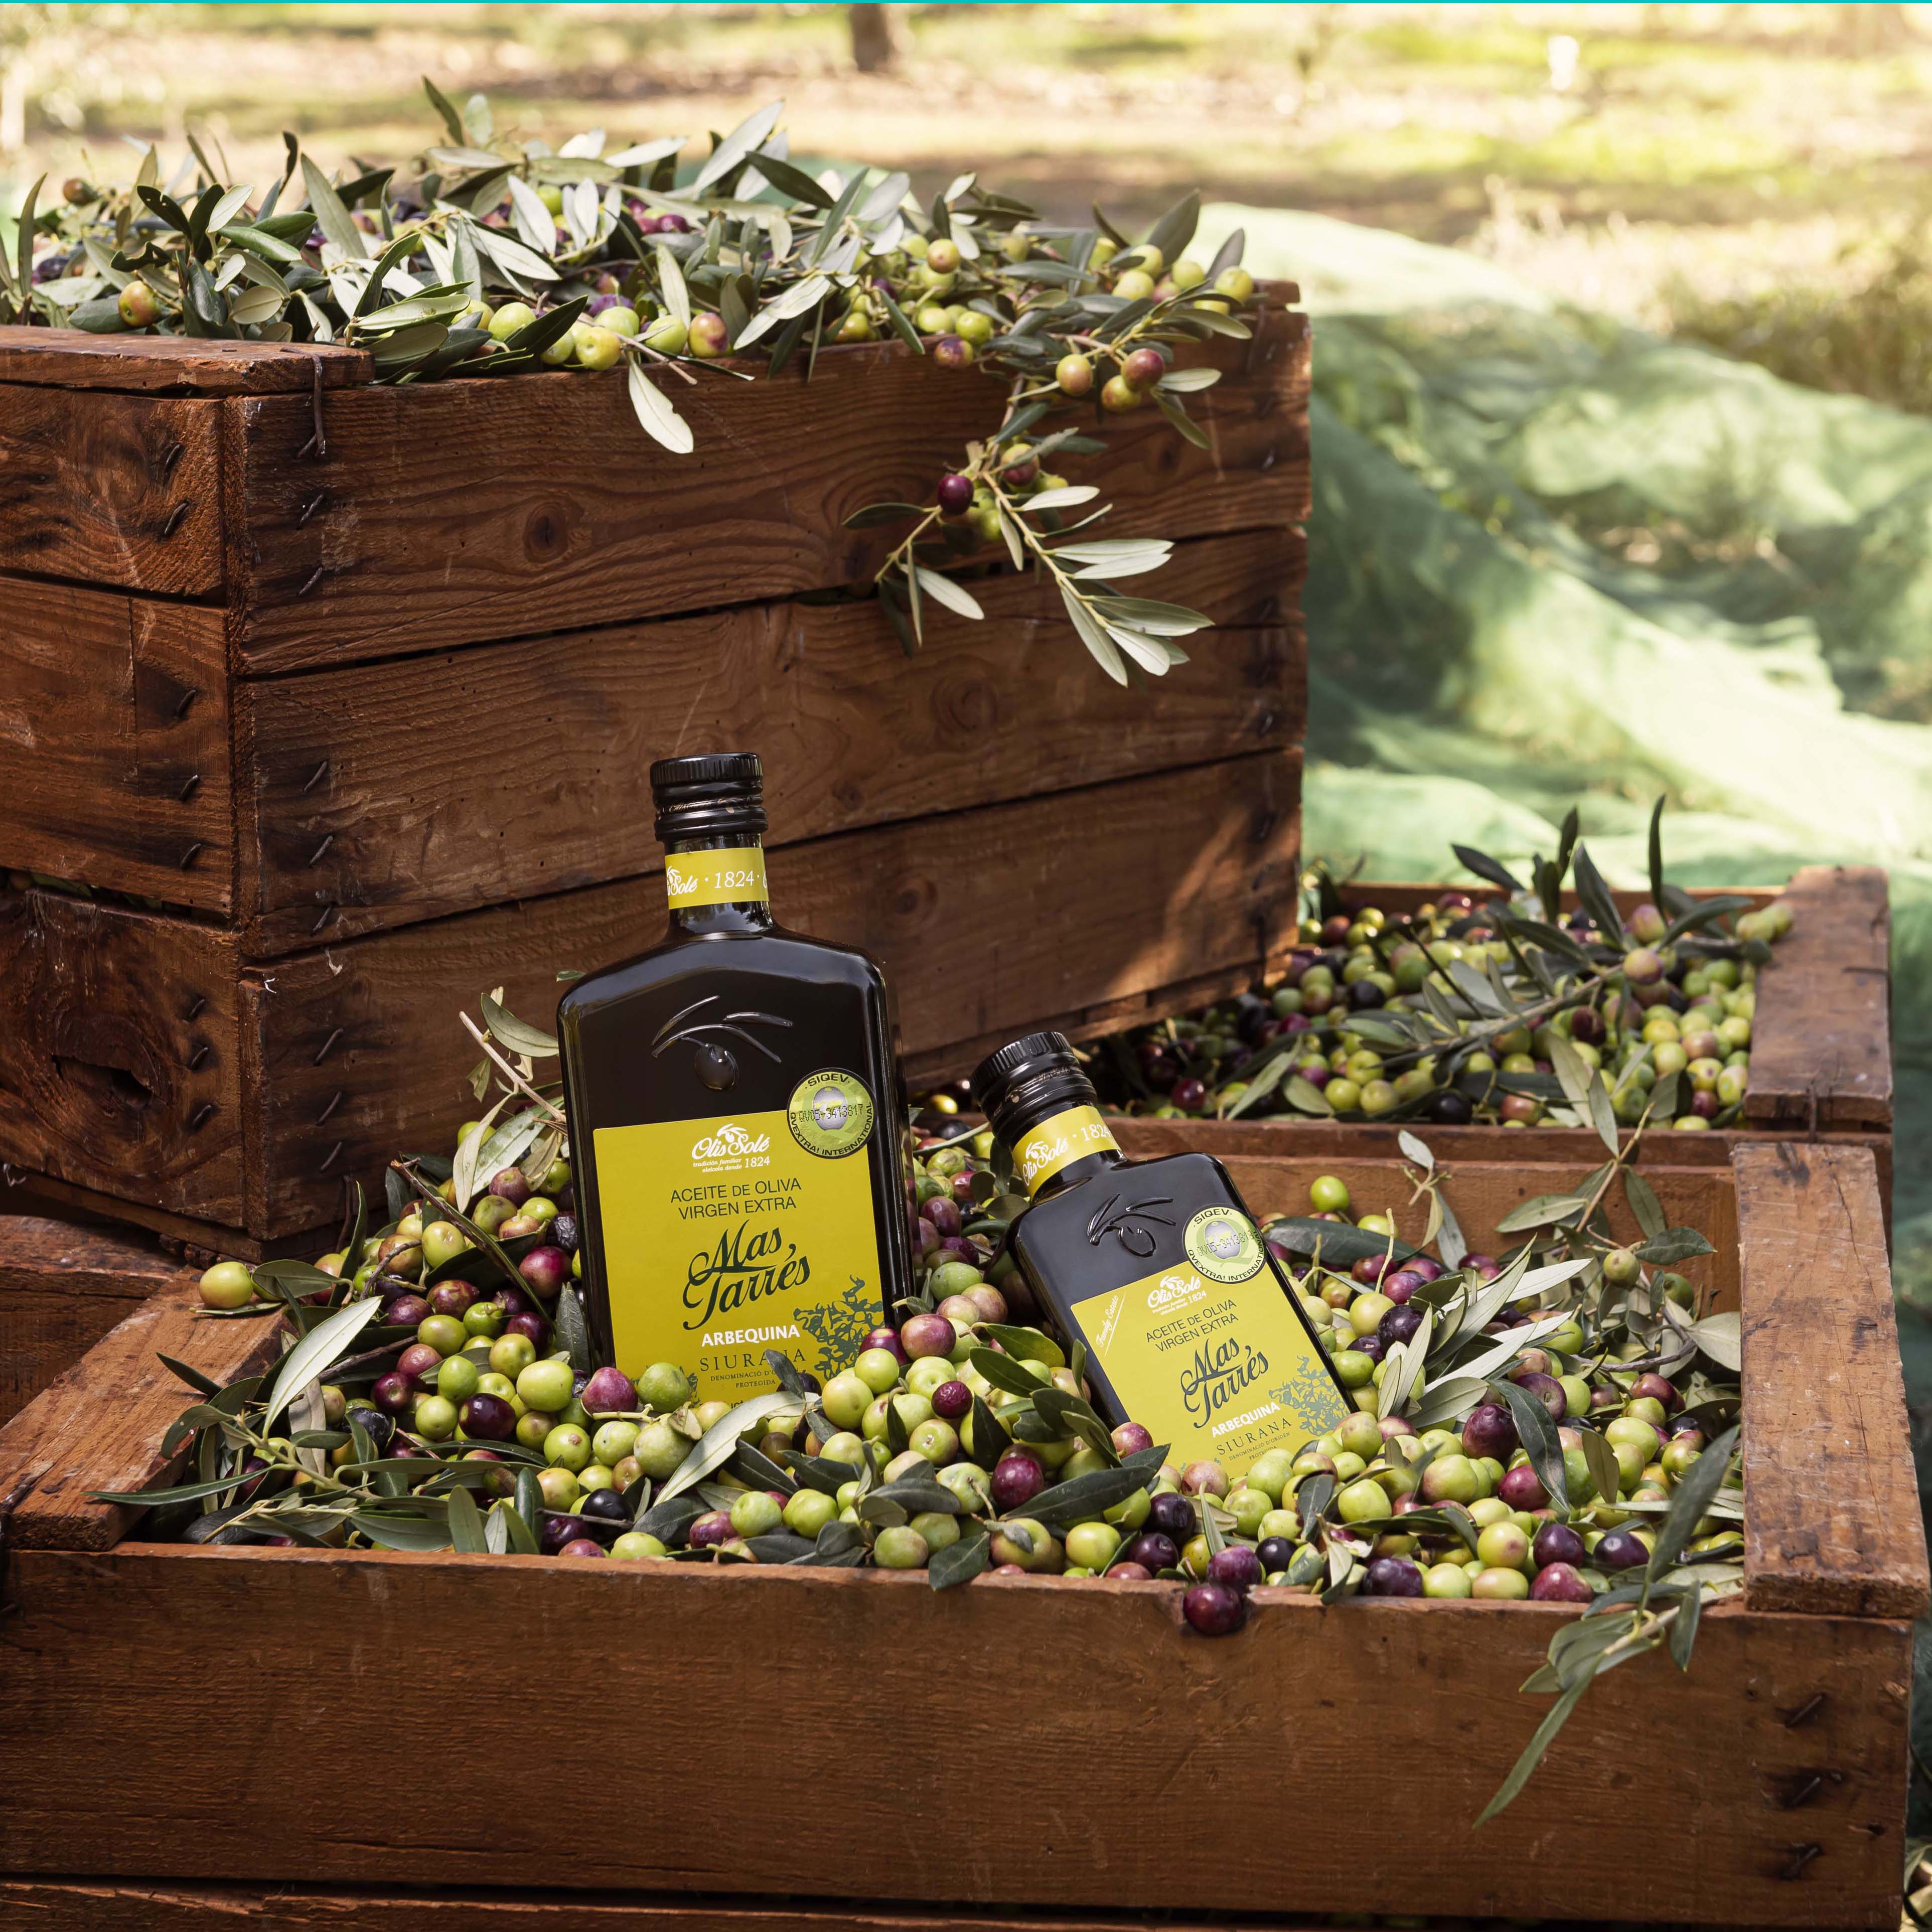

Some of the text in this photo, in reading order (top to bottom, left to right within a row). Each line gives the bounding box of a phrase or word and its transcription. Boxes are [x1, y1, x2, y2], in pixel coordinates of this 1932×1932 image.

[714, 870, 755, 889] 1824
[807, 1073, 849, 1087] SIQEV
[821, 1102, 873, 1156] INTERNATIONAL
[692, 1157, 742, 1167] tradición familiar
[745, 1155, 771, 1168] 1824
[670, 1177, 802, 1204] ACEITE DE OLIVA
[678, 1196, 797, 1220] VIRGEN EXTRA
[1194, 1208, 1230, 1225] SIQEV
[688, 1219, 782, 1286] Mas
[1228, 1230, 1264, 1281] INTERNATIONAL
[1187, 1290, 1207, 1303] 1824
[1146, 1319, 1186, 1343] ACEITE
[1187, 1313, 1203, 1325] DE
[1203, 1299, 1237, 1318] OLIVA
[1155, 1313, 1239, 1352] VIRGEN EXTRA
[701, 1324, 801, 1348] ARBEQUINA
[710, 1370, 763, 1382] DENOMINACIÓ
[1180, 1337, 1242, 1396] Mas
[735, 1380, 776, 1389] PROTEGIDA
[1211, 1402, 1281, 1438] ARBEQUINA
[1216, 1418, 1292, 1455] SIURANA
